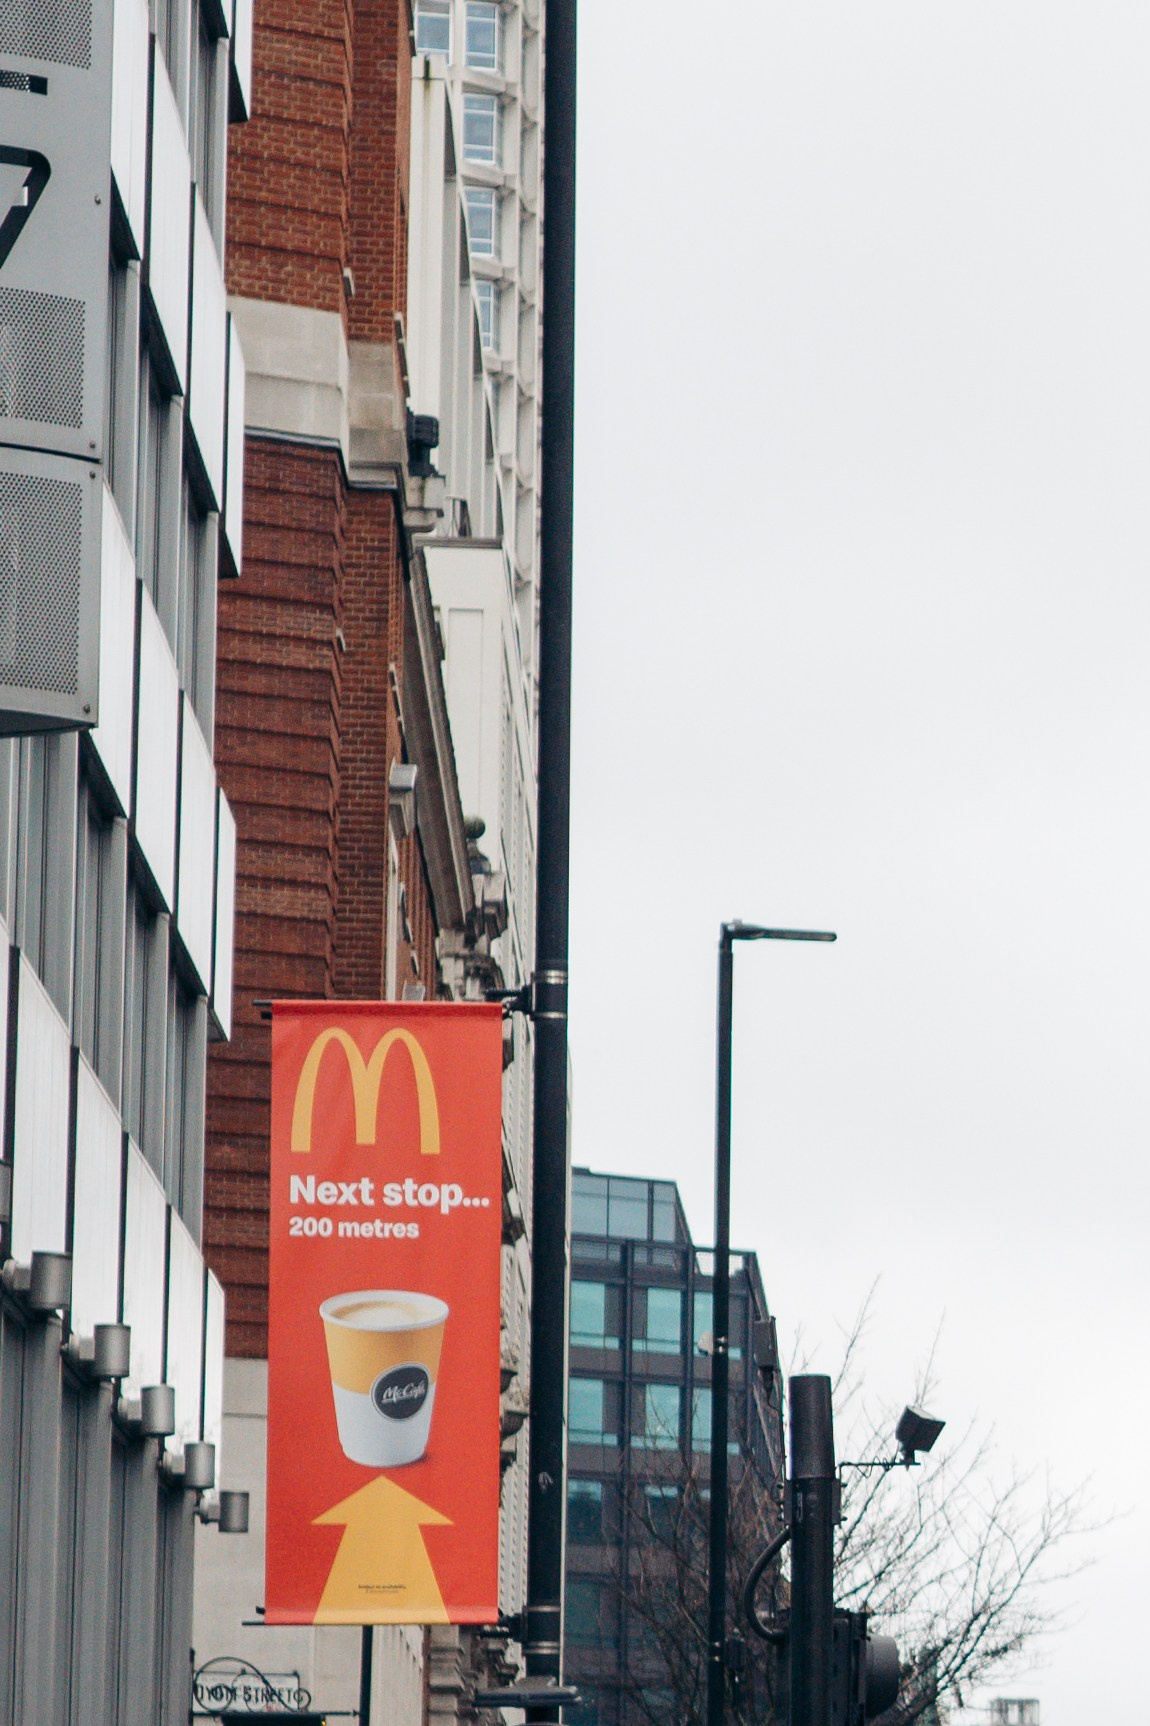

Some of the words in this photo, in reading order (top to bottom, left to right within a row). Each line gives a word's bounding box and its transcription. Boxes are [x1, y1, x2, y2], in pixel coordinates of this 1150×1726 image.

[289, 1174, 375, 1206] Next
[382, 1177, 490, 1215] stop...
[289, 1216, 333, 1237] 200
[338, 1218, 420, 1239] metres
